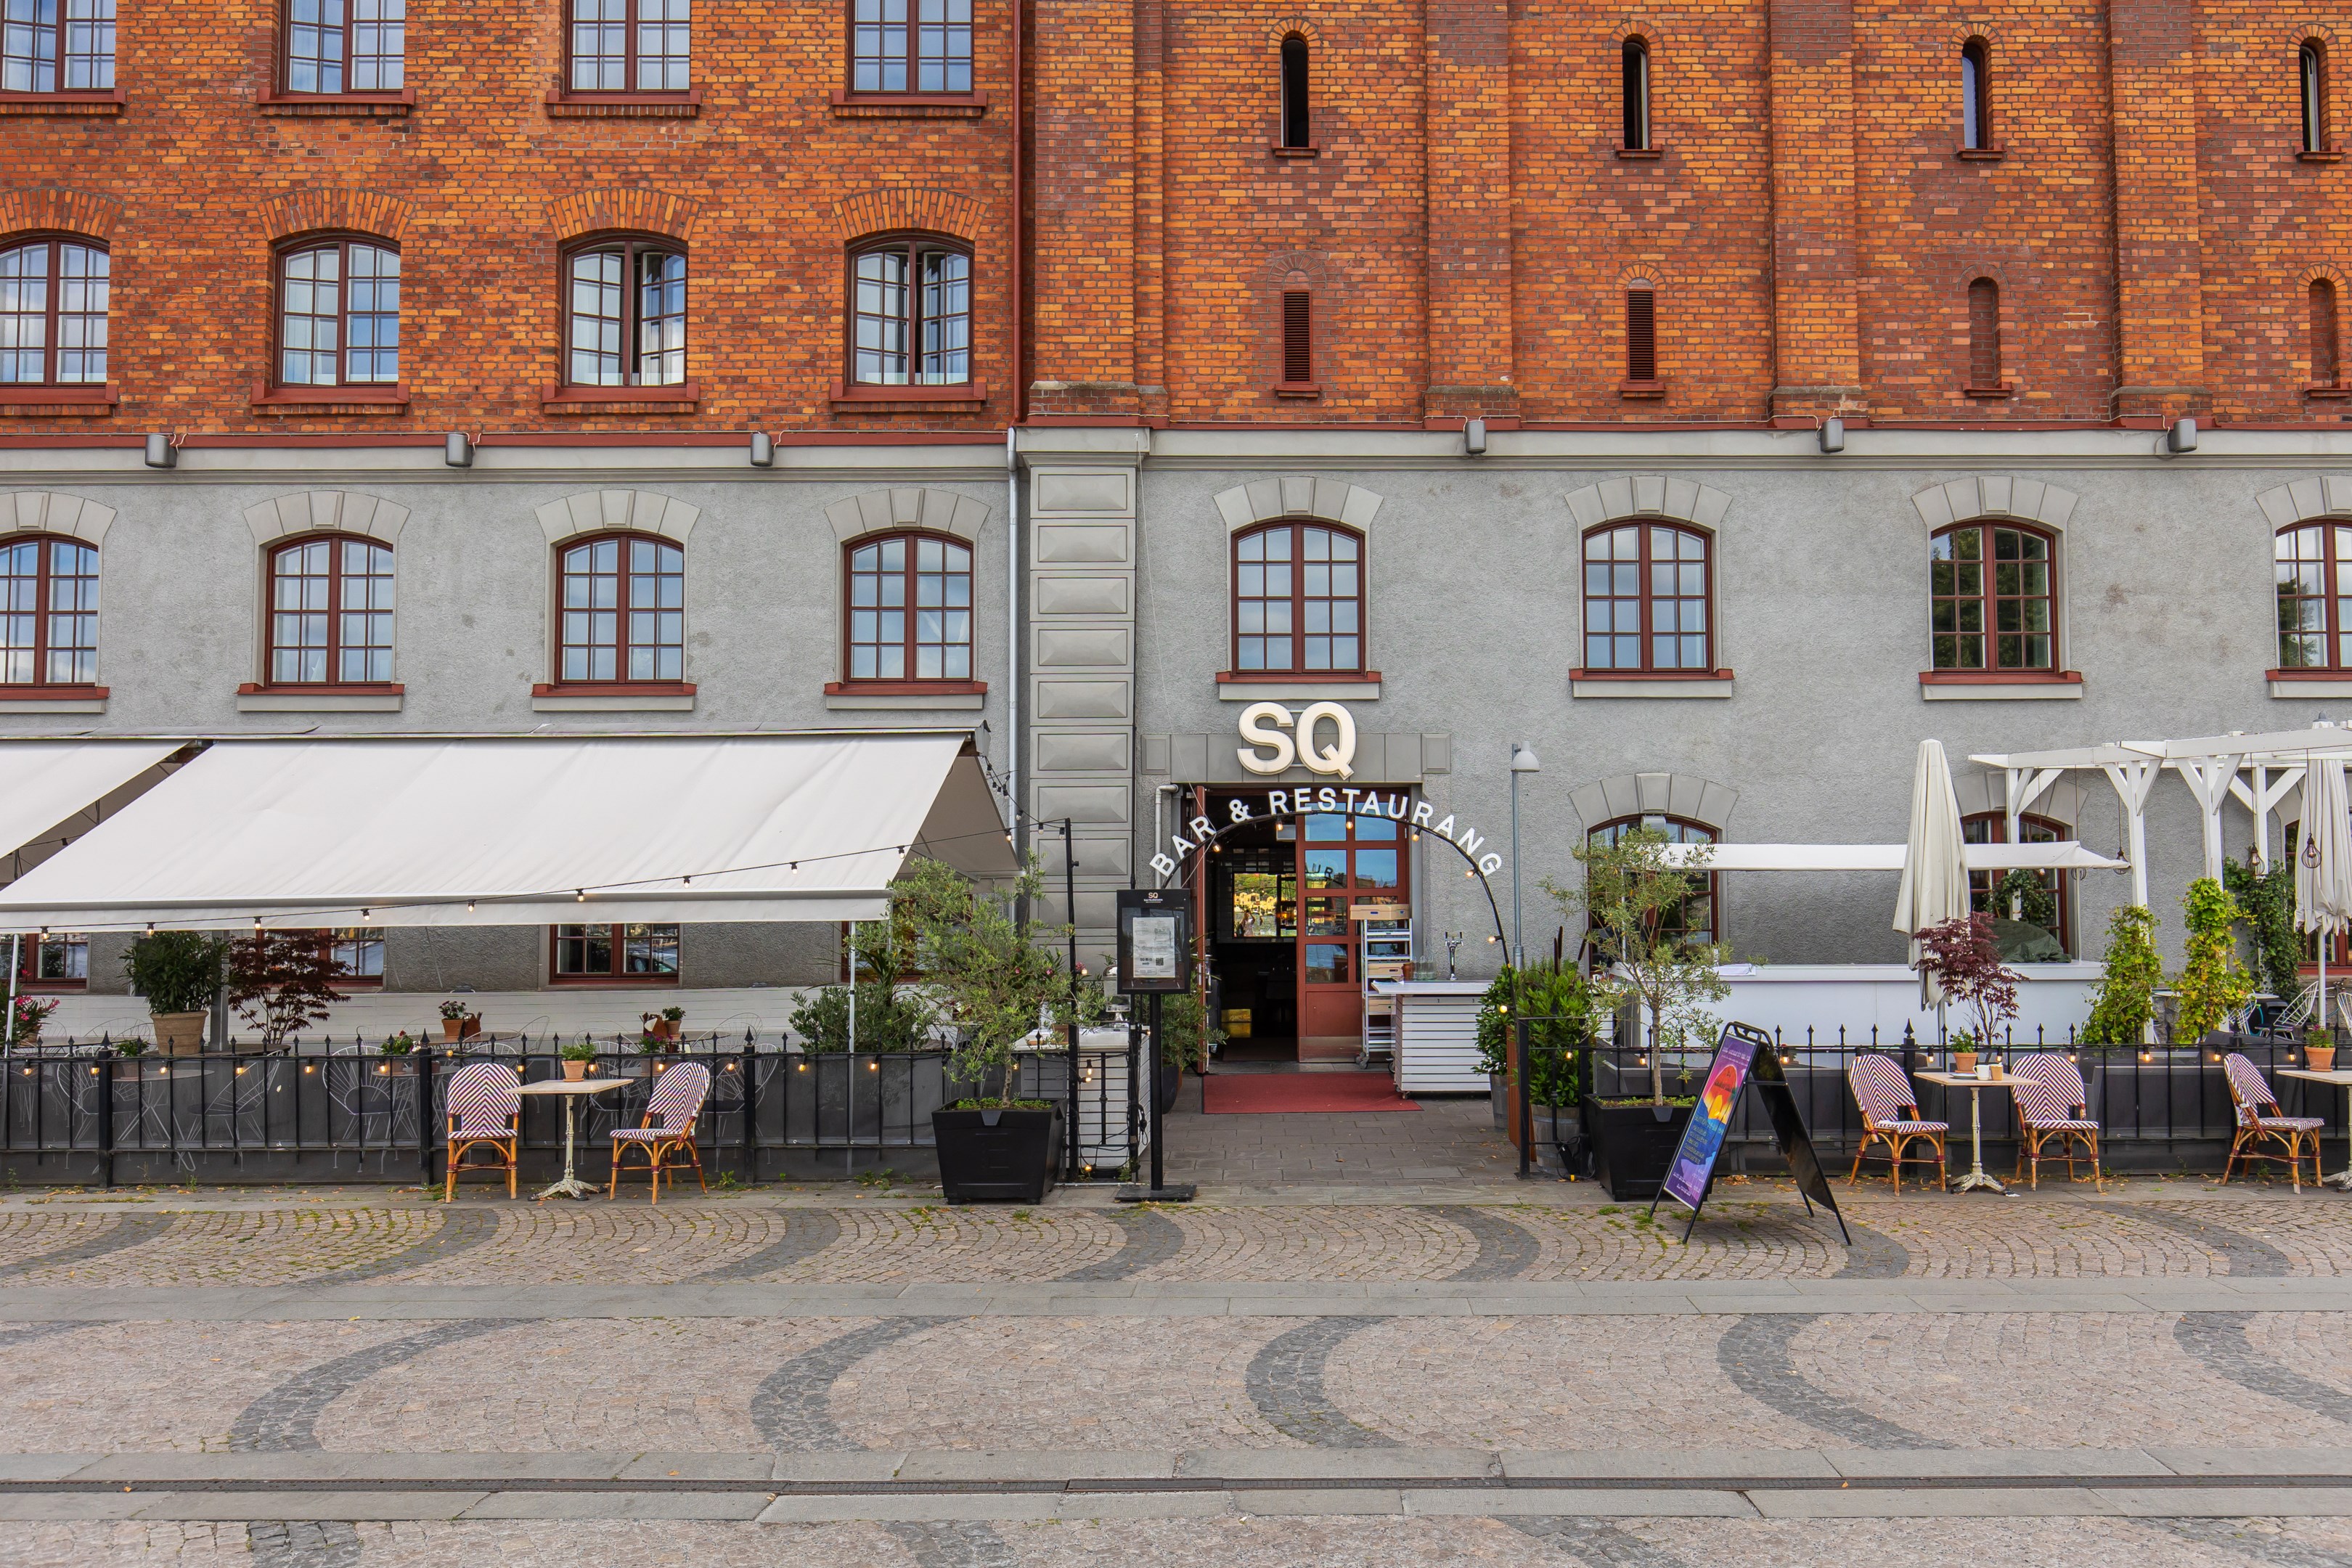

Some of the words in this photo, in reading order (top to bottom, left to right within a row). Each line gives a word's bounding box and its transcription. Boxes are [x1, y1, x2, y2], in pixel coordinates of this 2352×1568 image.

[1237, 701, 1356, 780] SQ
[1149, 816, 1217, 877] BAR
[1229, 799, 1253, 822] &
[1268, 788, 1502, 877] RESTAURANG
